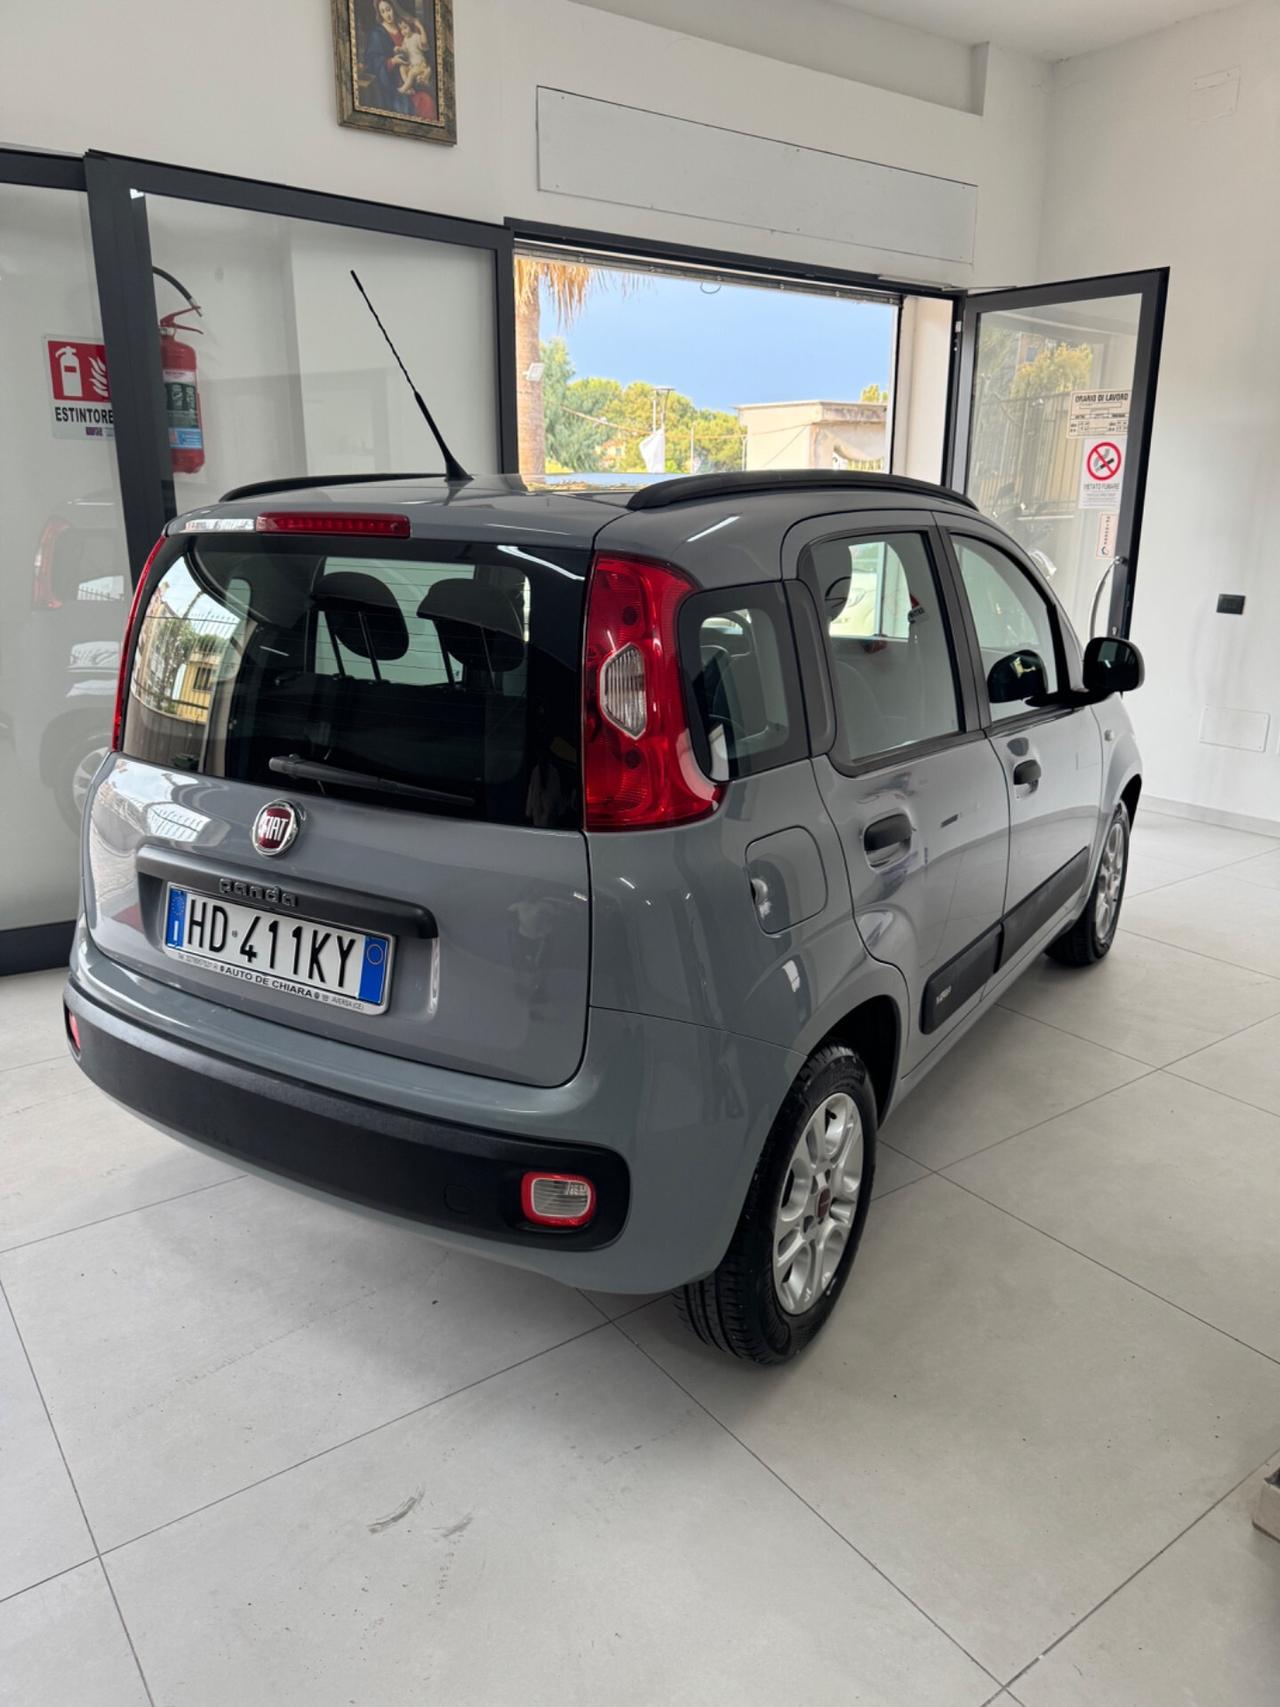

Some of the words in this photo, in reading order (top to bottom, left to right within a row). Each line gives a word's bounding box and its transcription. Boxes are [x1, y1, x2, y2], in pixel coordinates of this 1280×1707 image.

[1075, 394, 1097, 403] ORARIO
[1097, 394, 1105, 402] DI
[1105, 392, 1129, 402] LAVORO
[54, 406, 114, 424] ESTINTORE
[259, 814, 289, 841] FIAT
[187, 898, 229, 954] HD
[239, 915, 357, 989] 411KY
[225, 967, 254, 982] AUTO
[254, 975, 270, 986] DE
[271, 979, 313, 999] CHIARA
